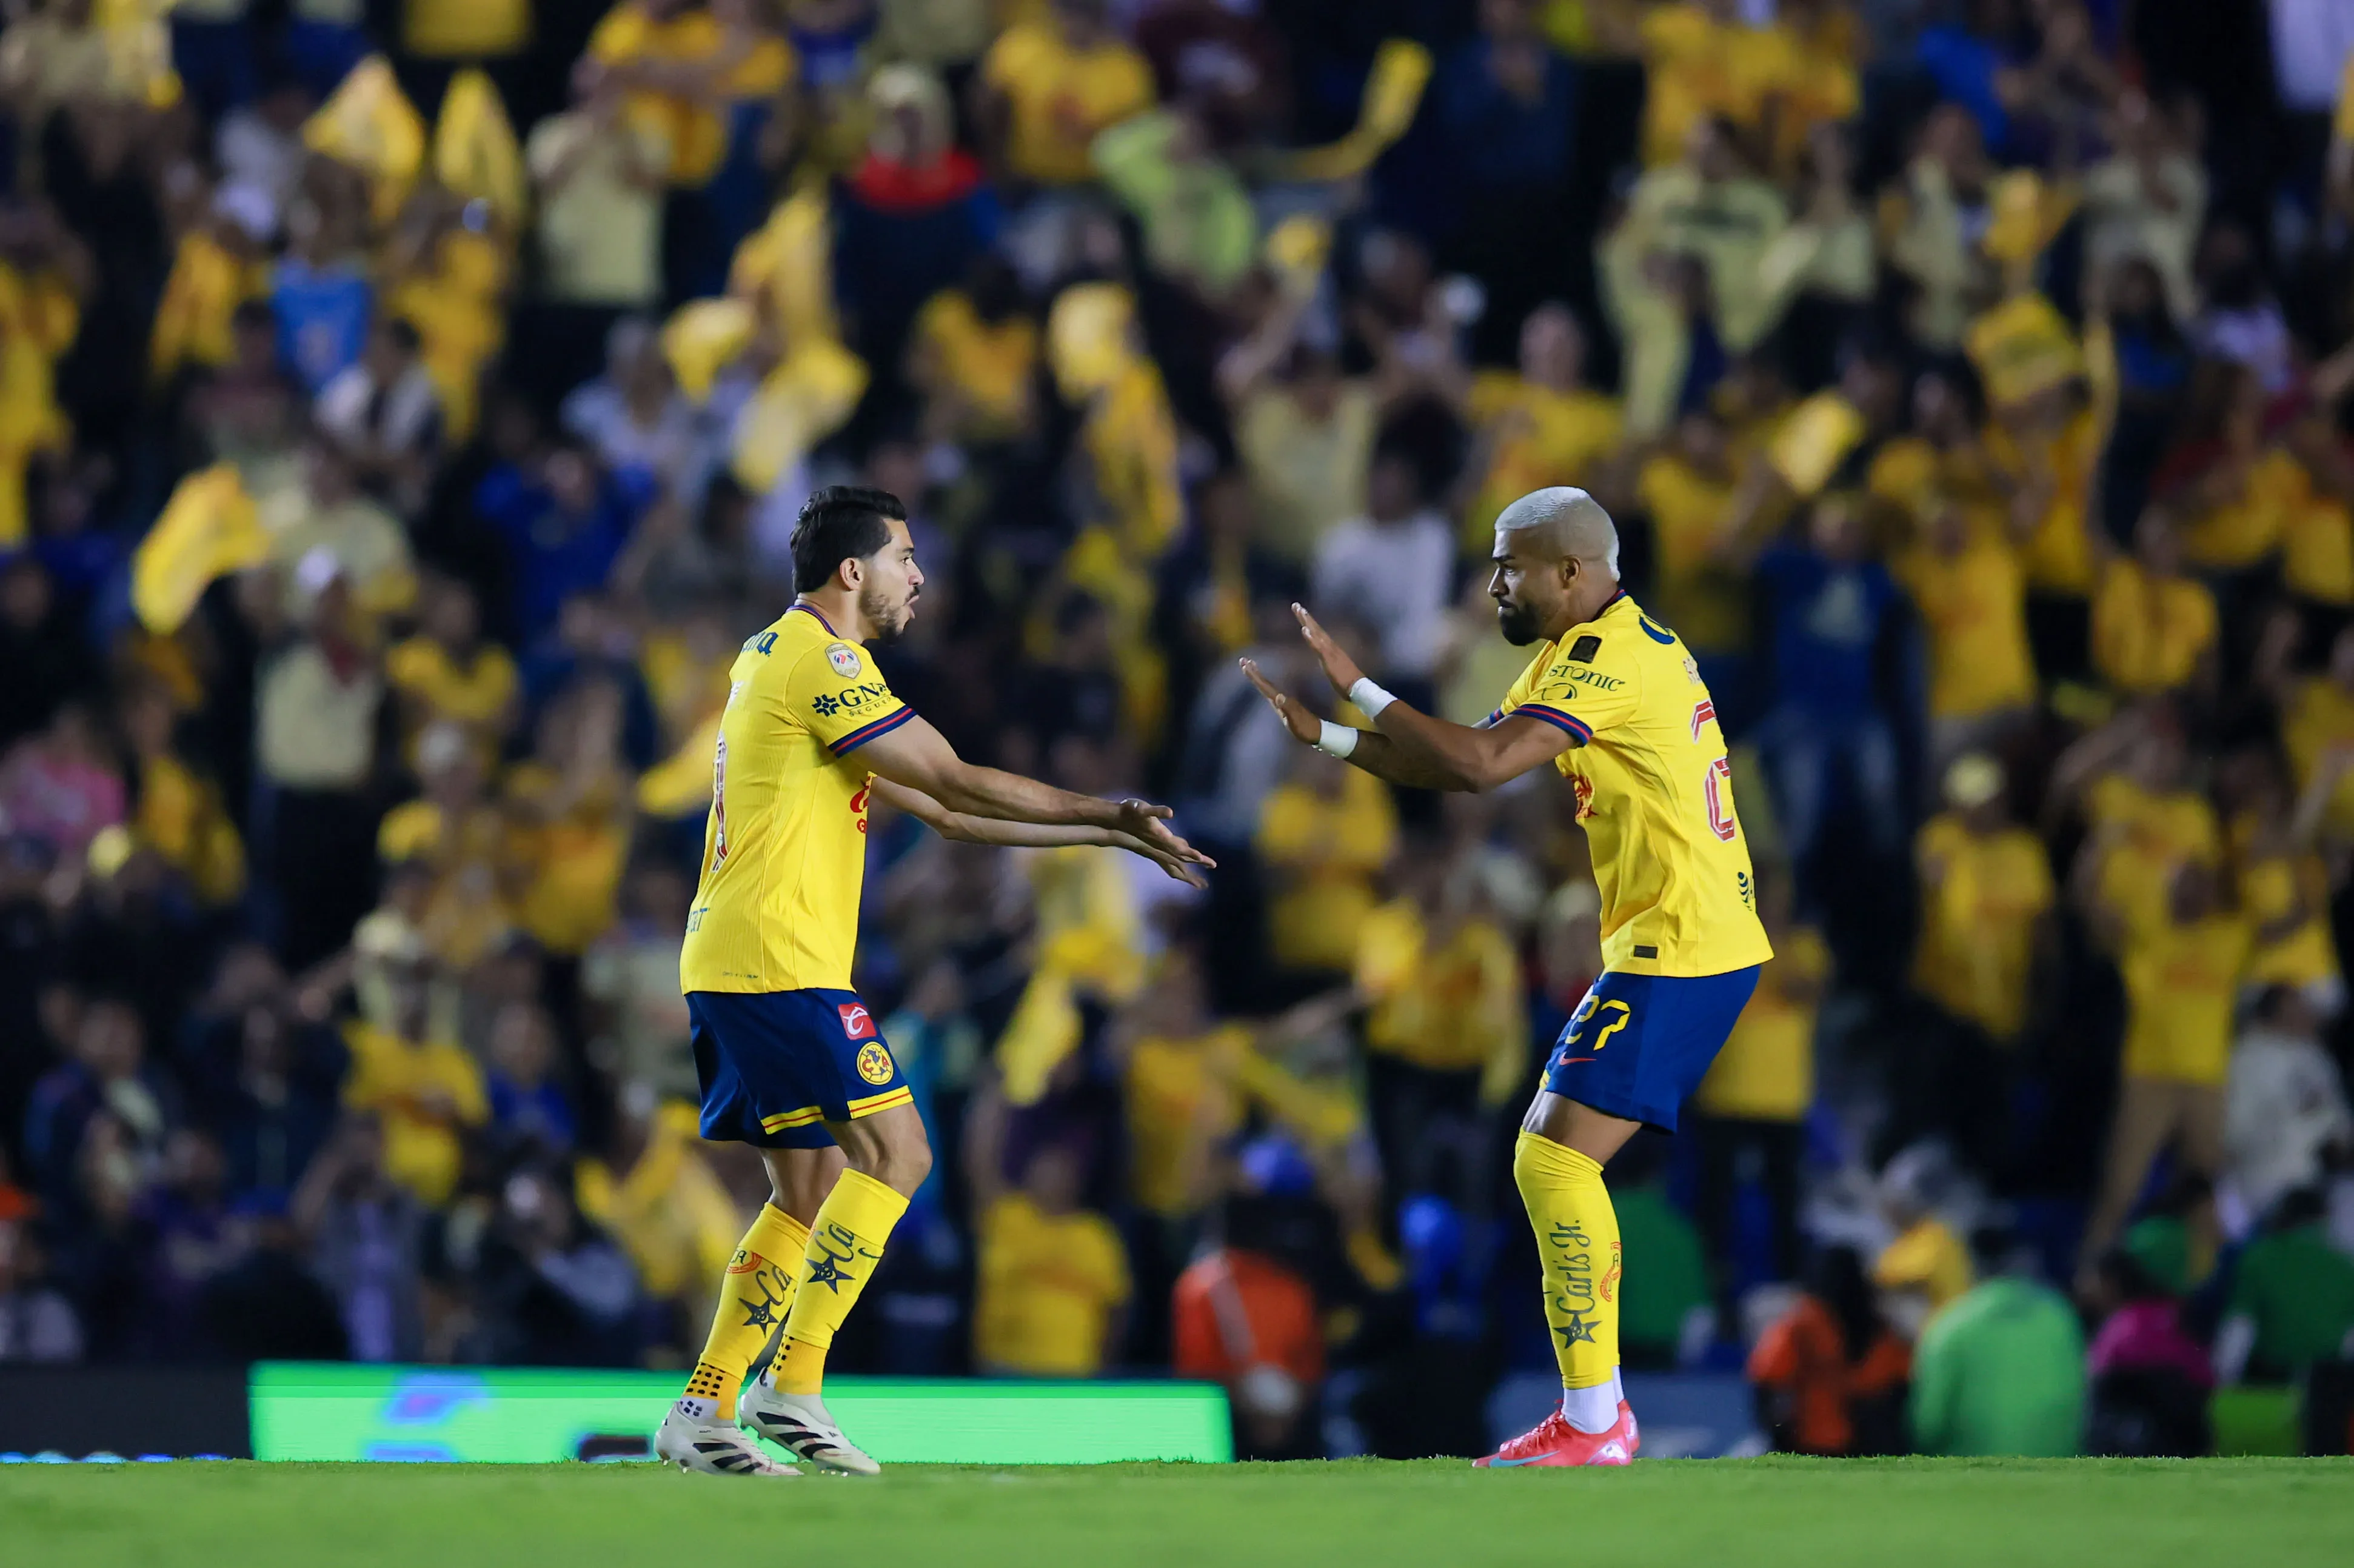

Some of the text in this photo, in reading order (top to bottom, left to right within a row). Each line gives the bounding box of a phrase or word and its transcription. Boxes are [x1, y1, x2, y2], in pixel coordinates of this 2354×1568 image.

[849, 696, 891, 717] SEGURO
[1565, 995, 1631, 1052] 27
[1549, 1219, 1596, 1315] Carl's Jr.
